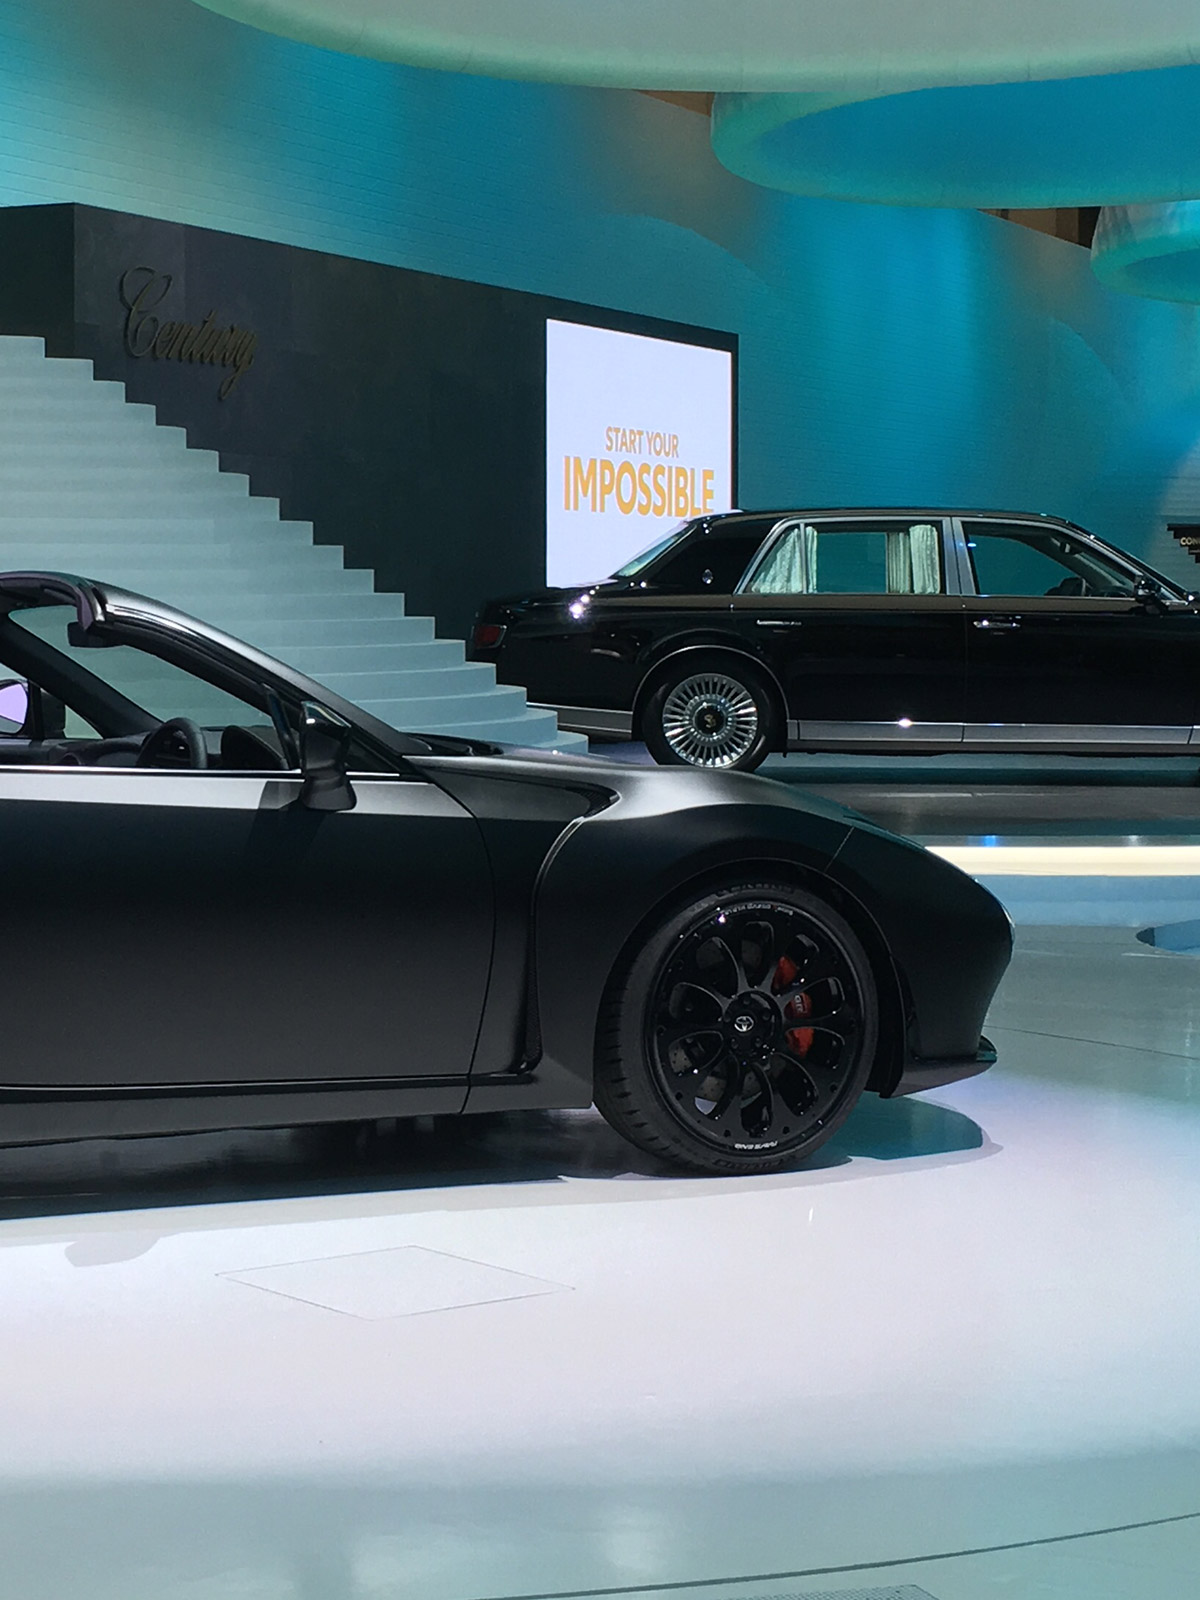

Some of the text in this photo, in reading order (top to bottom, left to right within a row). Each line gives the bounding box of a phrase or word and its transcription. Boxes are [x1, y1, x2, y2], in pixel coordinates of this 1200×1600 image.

[119, 265, 256, 401] Century
[605, 426, 679, 458] START YOUR
[564, 456, 714, 518] IMPOSSIBLE
